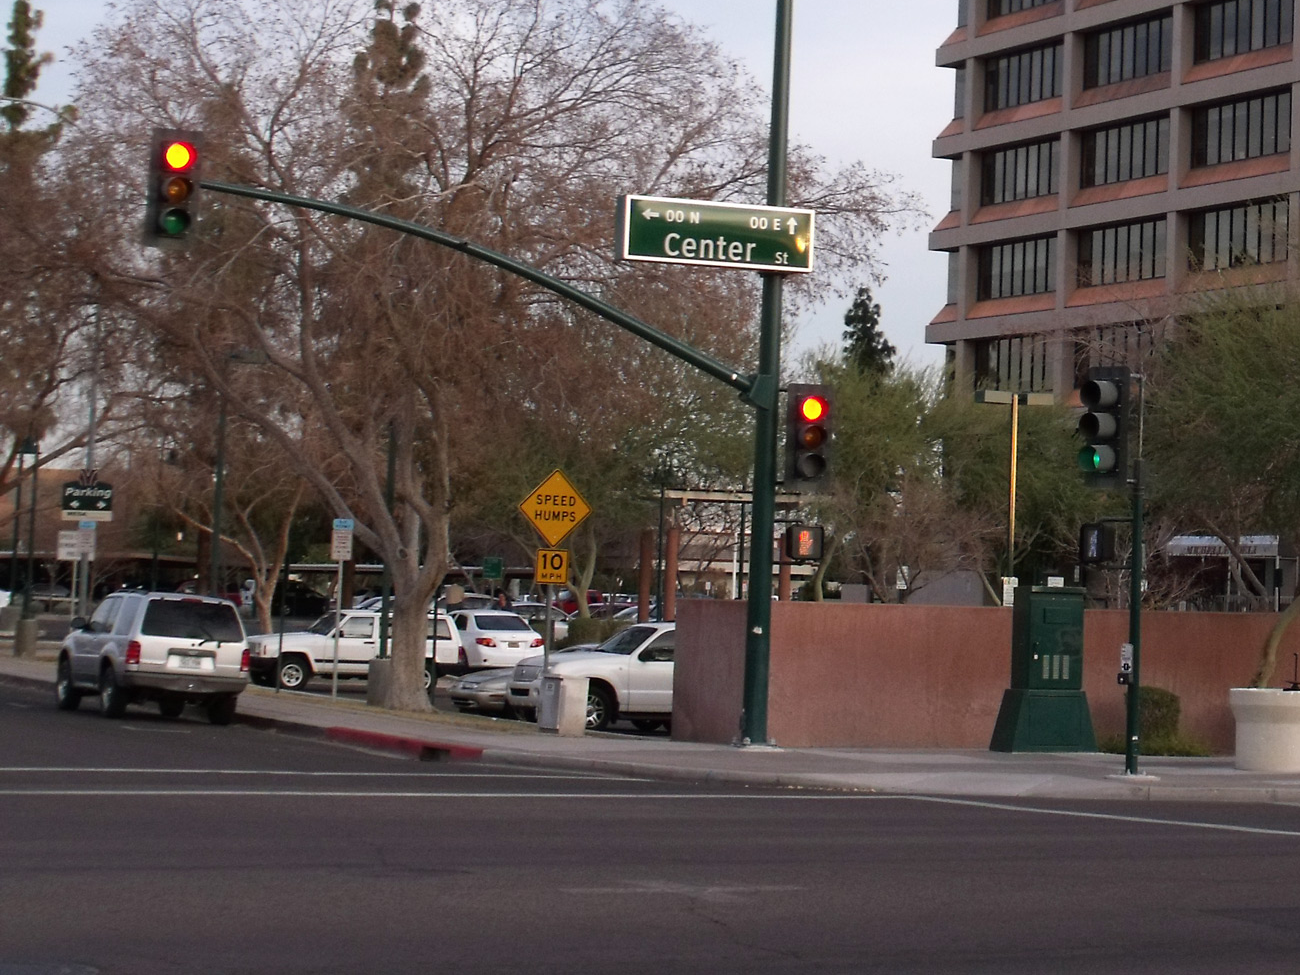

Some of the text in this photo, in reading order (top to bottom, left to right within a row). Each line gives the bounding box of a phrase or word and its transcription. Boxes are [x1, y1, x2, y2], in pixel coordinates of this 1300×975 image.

[666, 209, 700, 224] 00 N
[750, 216, 781, 231] 00 E
[664, 232, 789, 265] Center St
[65, 487, 112, 499] Parking
[536, 494, 576, 507] SPEED
[534, 510, 576, 522] HUMPS
[541, 553, 563, 570] 10
[541, 572, 562, 580] MPH
